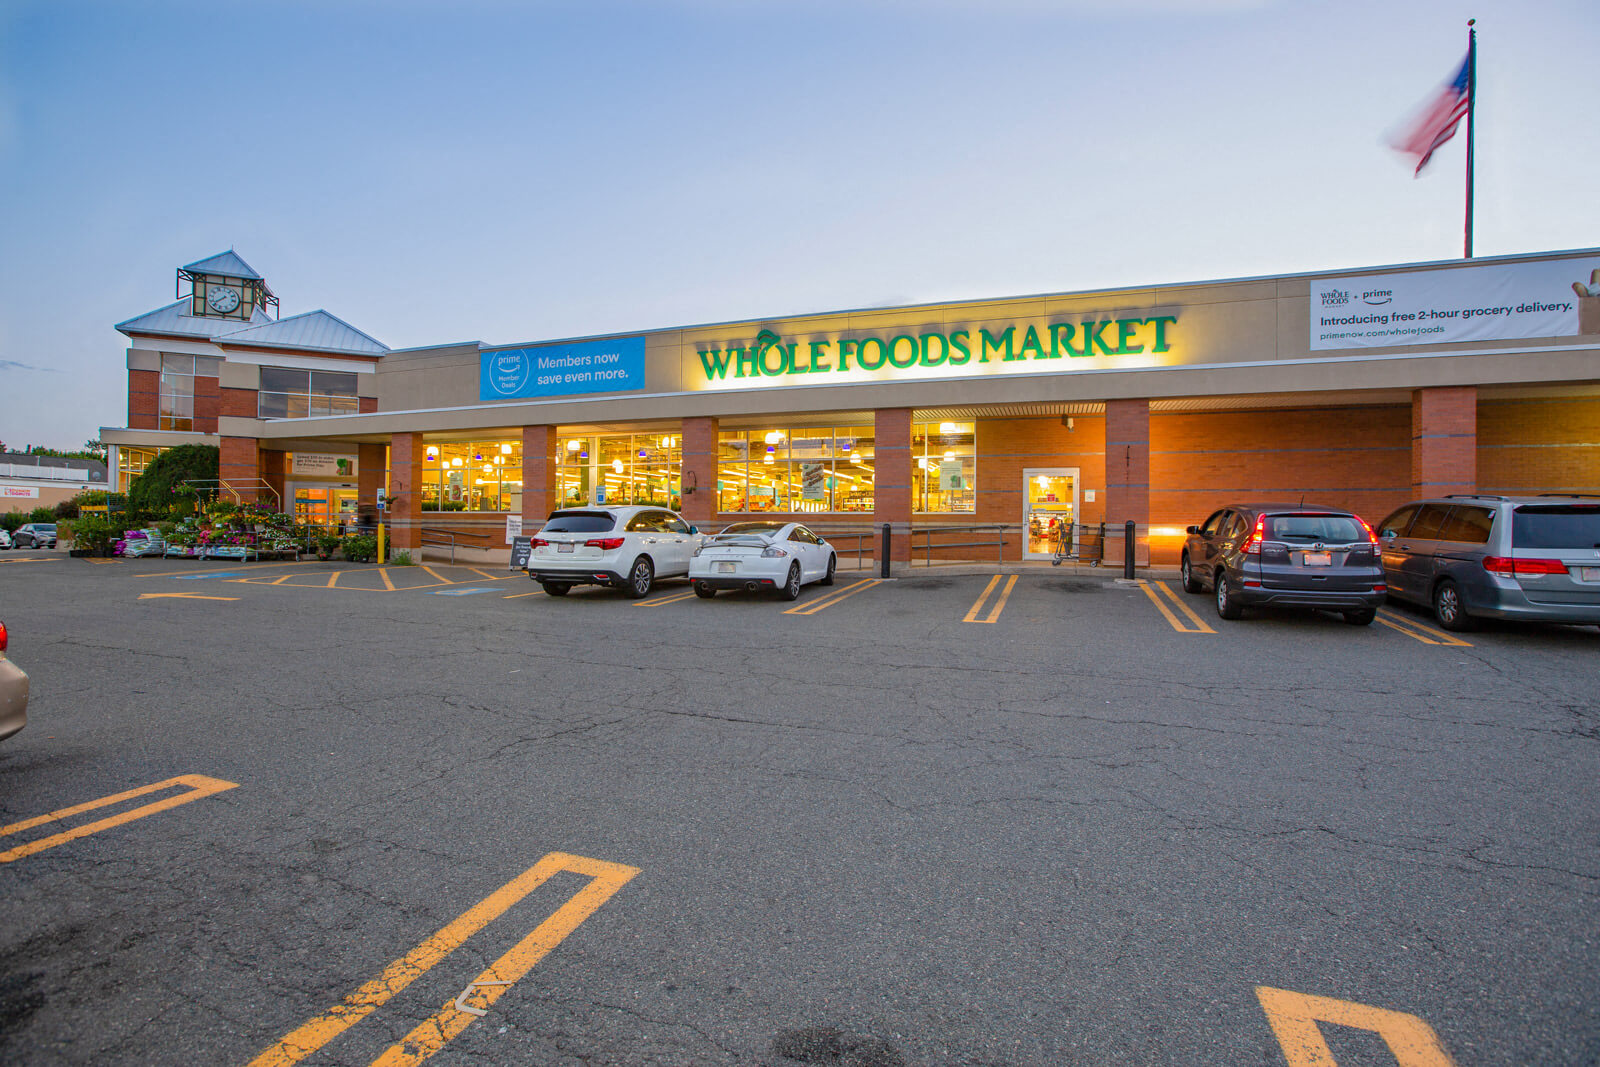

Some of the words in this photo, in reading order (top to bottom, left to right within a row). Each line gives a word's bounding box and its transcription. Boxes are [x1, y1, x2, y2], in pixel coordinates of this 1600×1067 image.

[1320, 289, 1349, 299] WHOLE
[1363, 290, 1392, 299] prime
[1320, 313, 1388, 325] Introducing
[1391, 312, 1415, 322] free
[1418, 309, 1460, 320] 2-hour
[1462, 305, 1513, 319] grocery
[1515, 301, 1573, 314] delivery.
[1320, 325, 1445, 340] primenow.com/wholefoods
[697, 333, 832, 381] WHOLE
[836, 330, 972, 371] FOODS
[978, 316, 1178, 363] MARKET
[498, 355, 520, 366] prime
[538, 354, 592, 369] Members
[594, 352, 620, 364] now
[537, 374, 562, 385] save
[564, 372, 592, 383] even
[594, 369, 629, 380] more.
